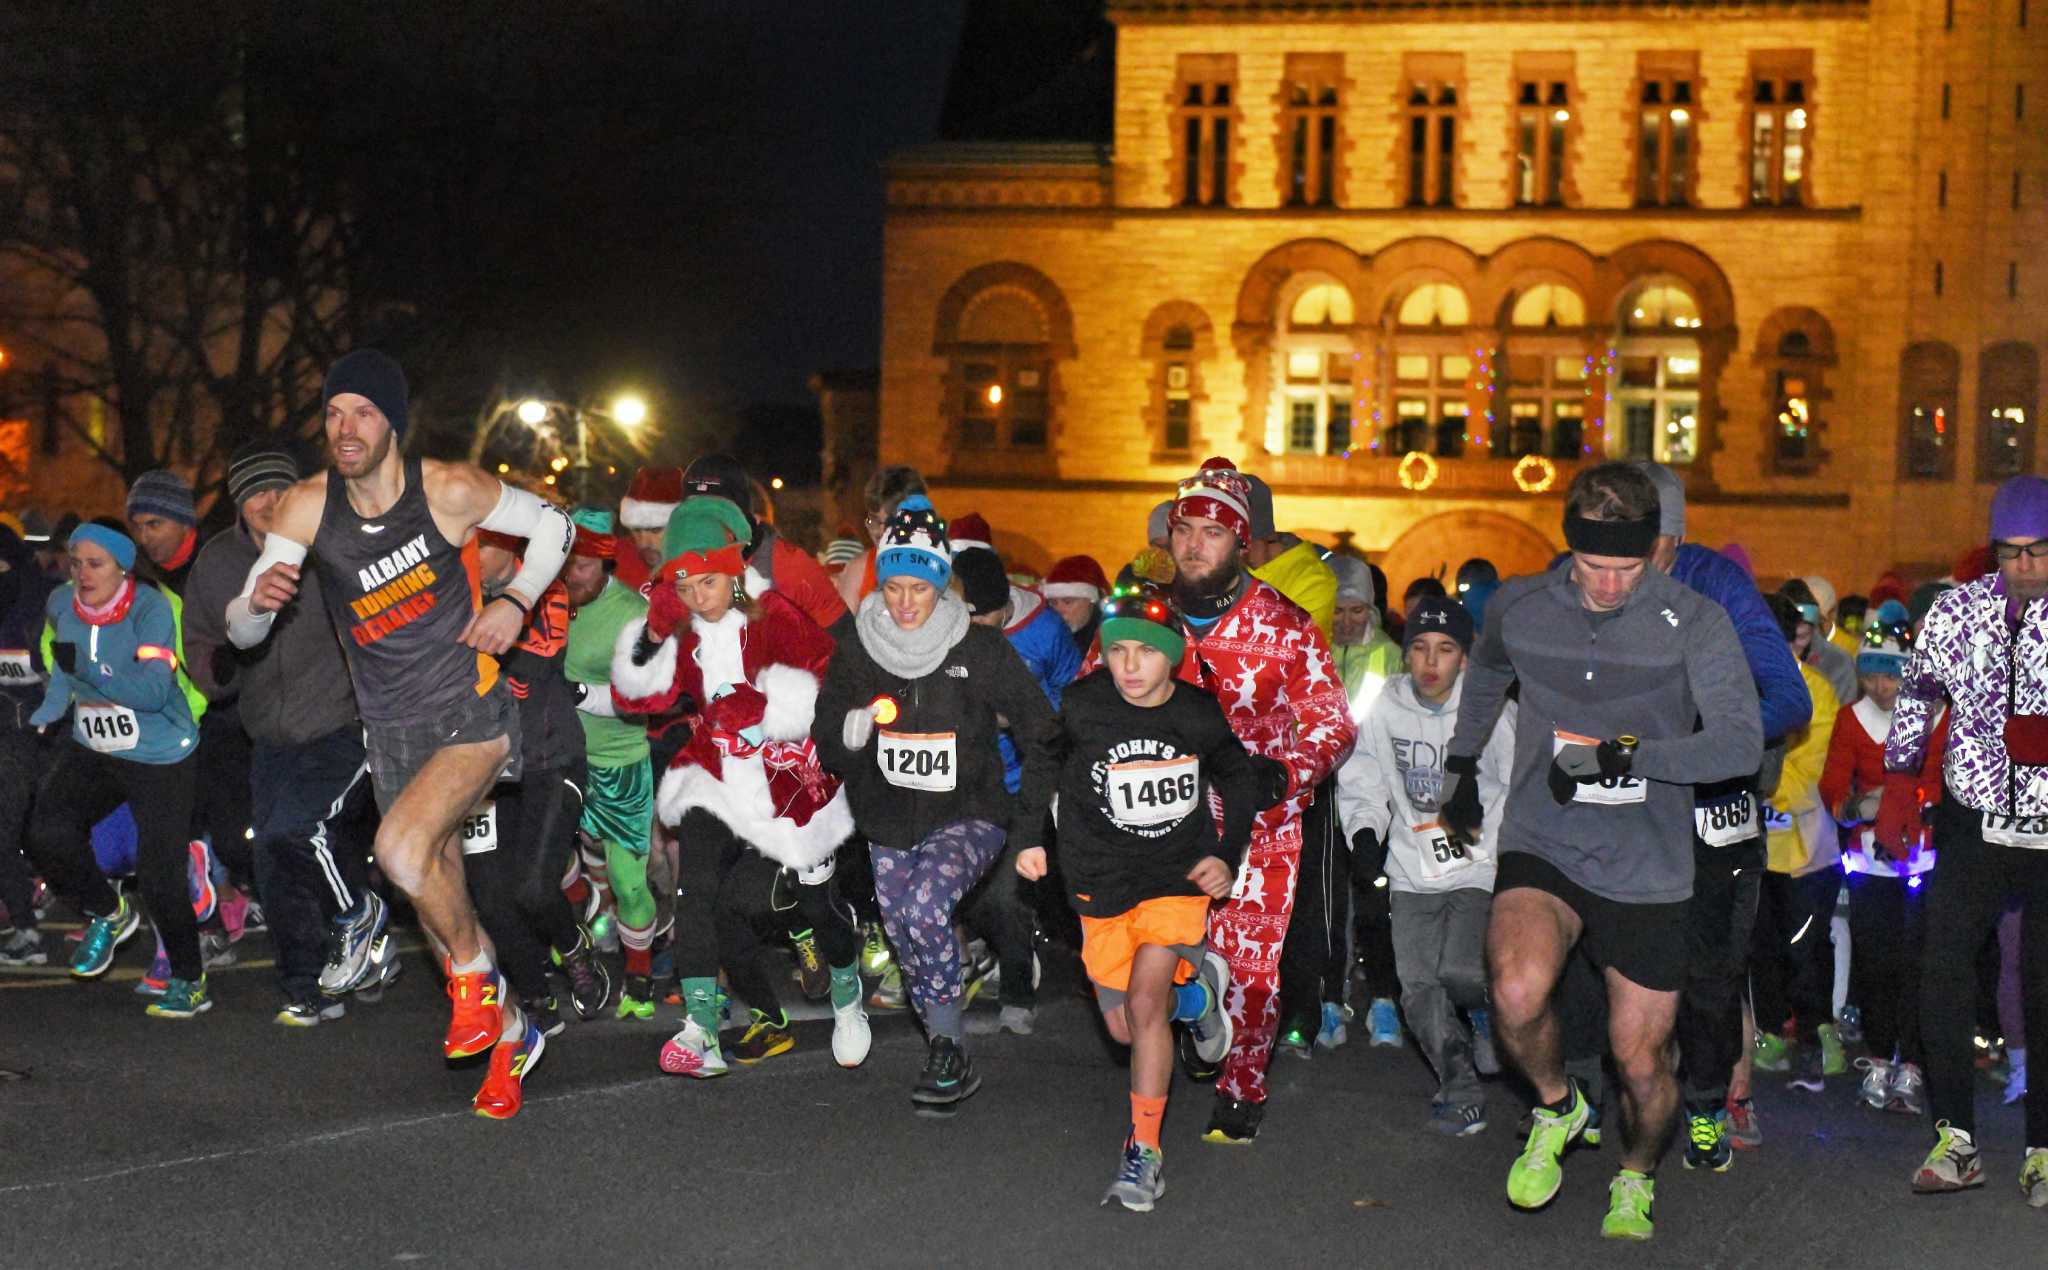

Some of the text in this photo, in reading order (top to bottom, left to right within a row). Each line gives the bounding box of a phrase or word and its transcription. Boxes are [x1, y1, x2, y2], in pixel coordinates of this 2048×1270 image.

[358, 533, 431, 593] ALBANY
[82, 714, 134, 739] 1416
[883, 748, 950, 777] 1204
[1108, 739, 1176, 764] JOHN'S
[1118, 773, 1195, 810] 1466
